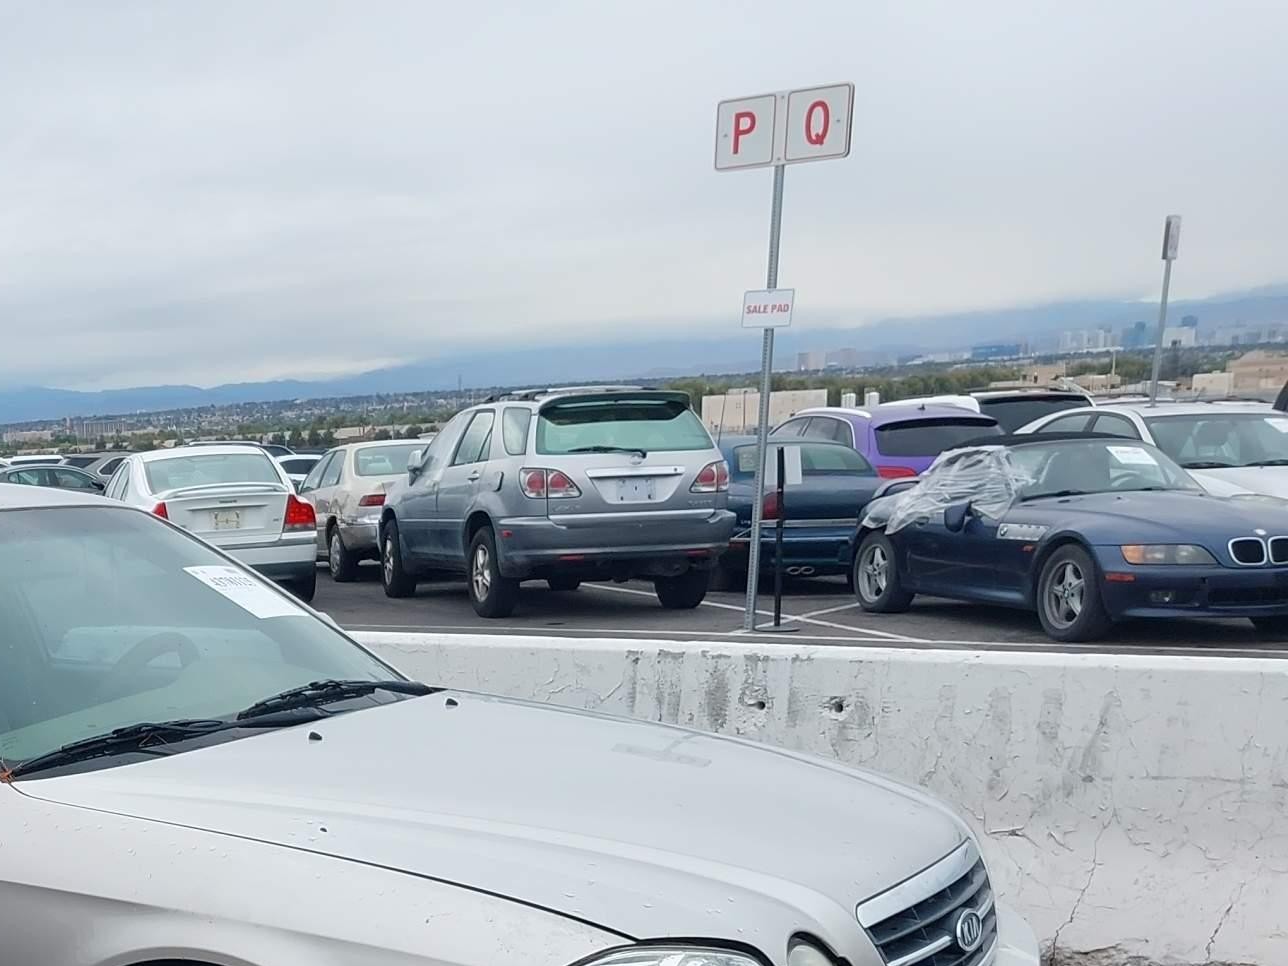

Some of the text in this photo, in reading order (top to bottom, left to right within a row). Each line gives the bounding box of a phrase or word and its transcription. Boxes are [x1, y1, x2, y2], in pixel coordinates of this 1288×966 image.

[732, 100, 830, 155] P Q
[746, 303, 790, 314] SALE PAD
